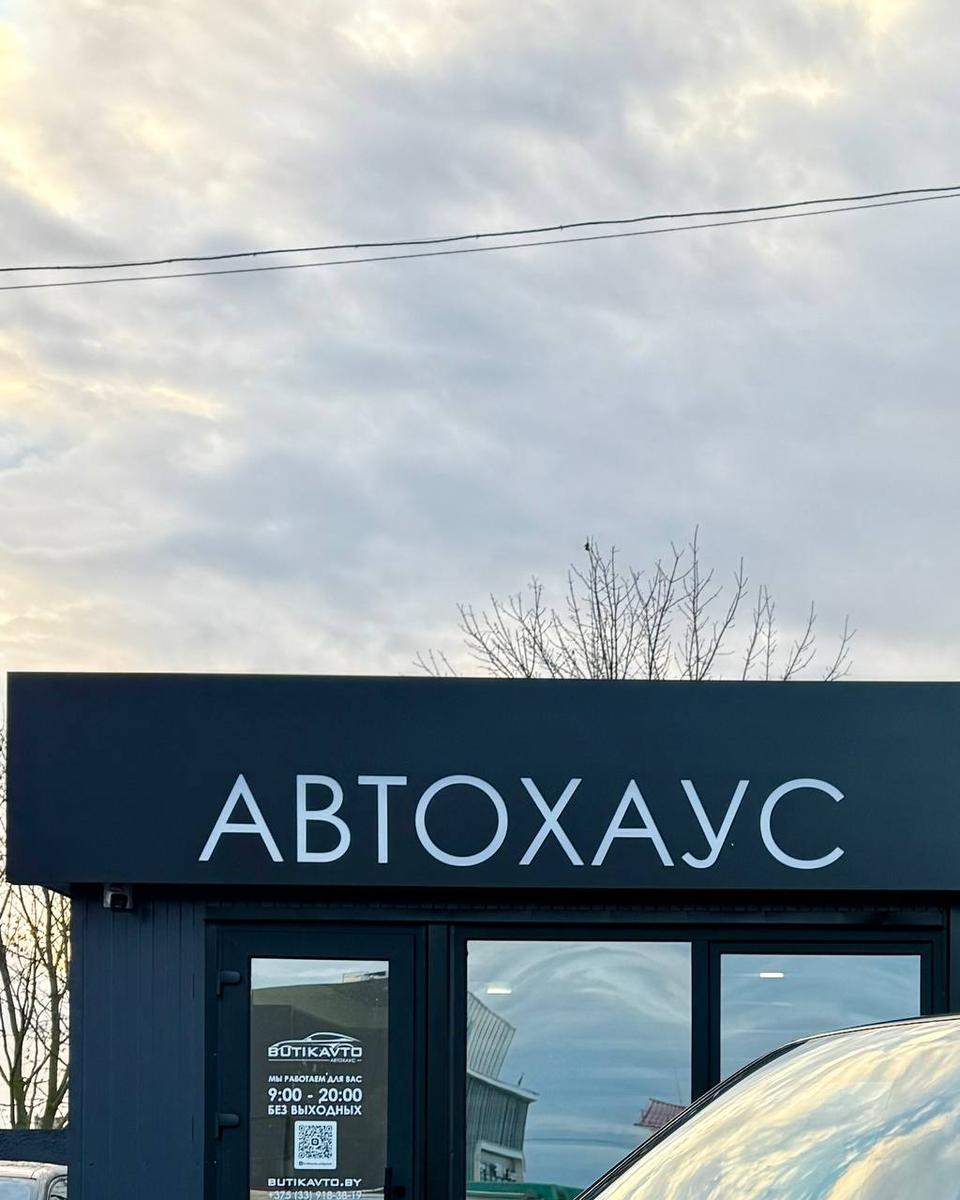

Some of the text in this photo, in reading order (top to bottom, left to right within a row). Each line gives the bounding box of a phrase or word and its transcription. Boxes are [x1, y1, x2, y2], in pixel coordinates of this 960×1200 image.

[198, 773, 846, 870] АВТОХАУС
[267, 1046, 363, 1058] BUTIKAVTO
[268, 1075, 363, 1084] МЫ РАБОТАЕМ ДЛЯ ВАС
[268, 1087, 303, 1102] 9:00
[318, 1087, 363, 1103] 20:00
[267, 1104, 363, 1116] БЕЗ ВЫХОДНЫХ
[267, 1178, 363, 1187] BUTIKAVTO.BY
[294, 1190, 313, 1200] (33)
